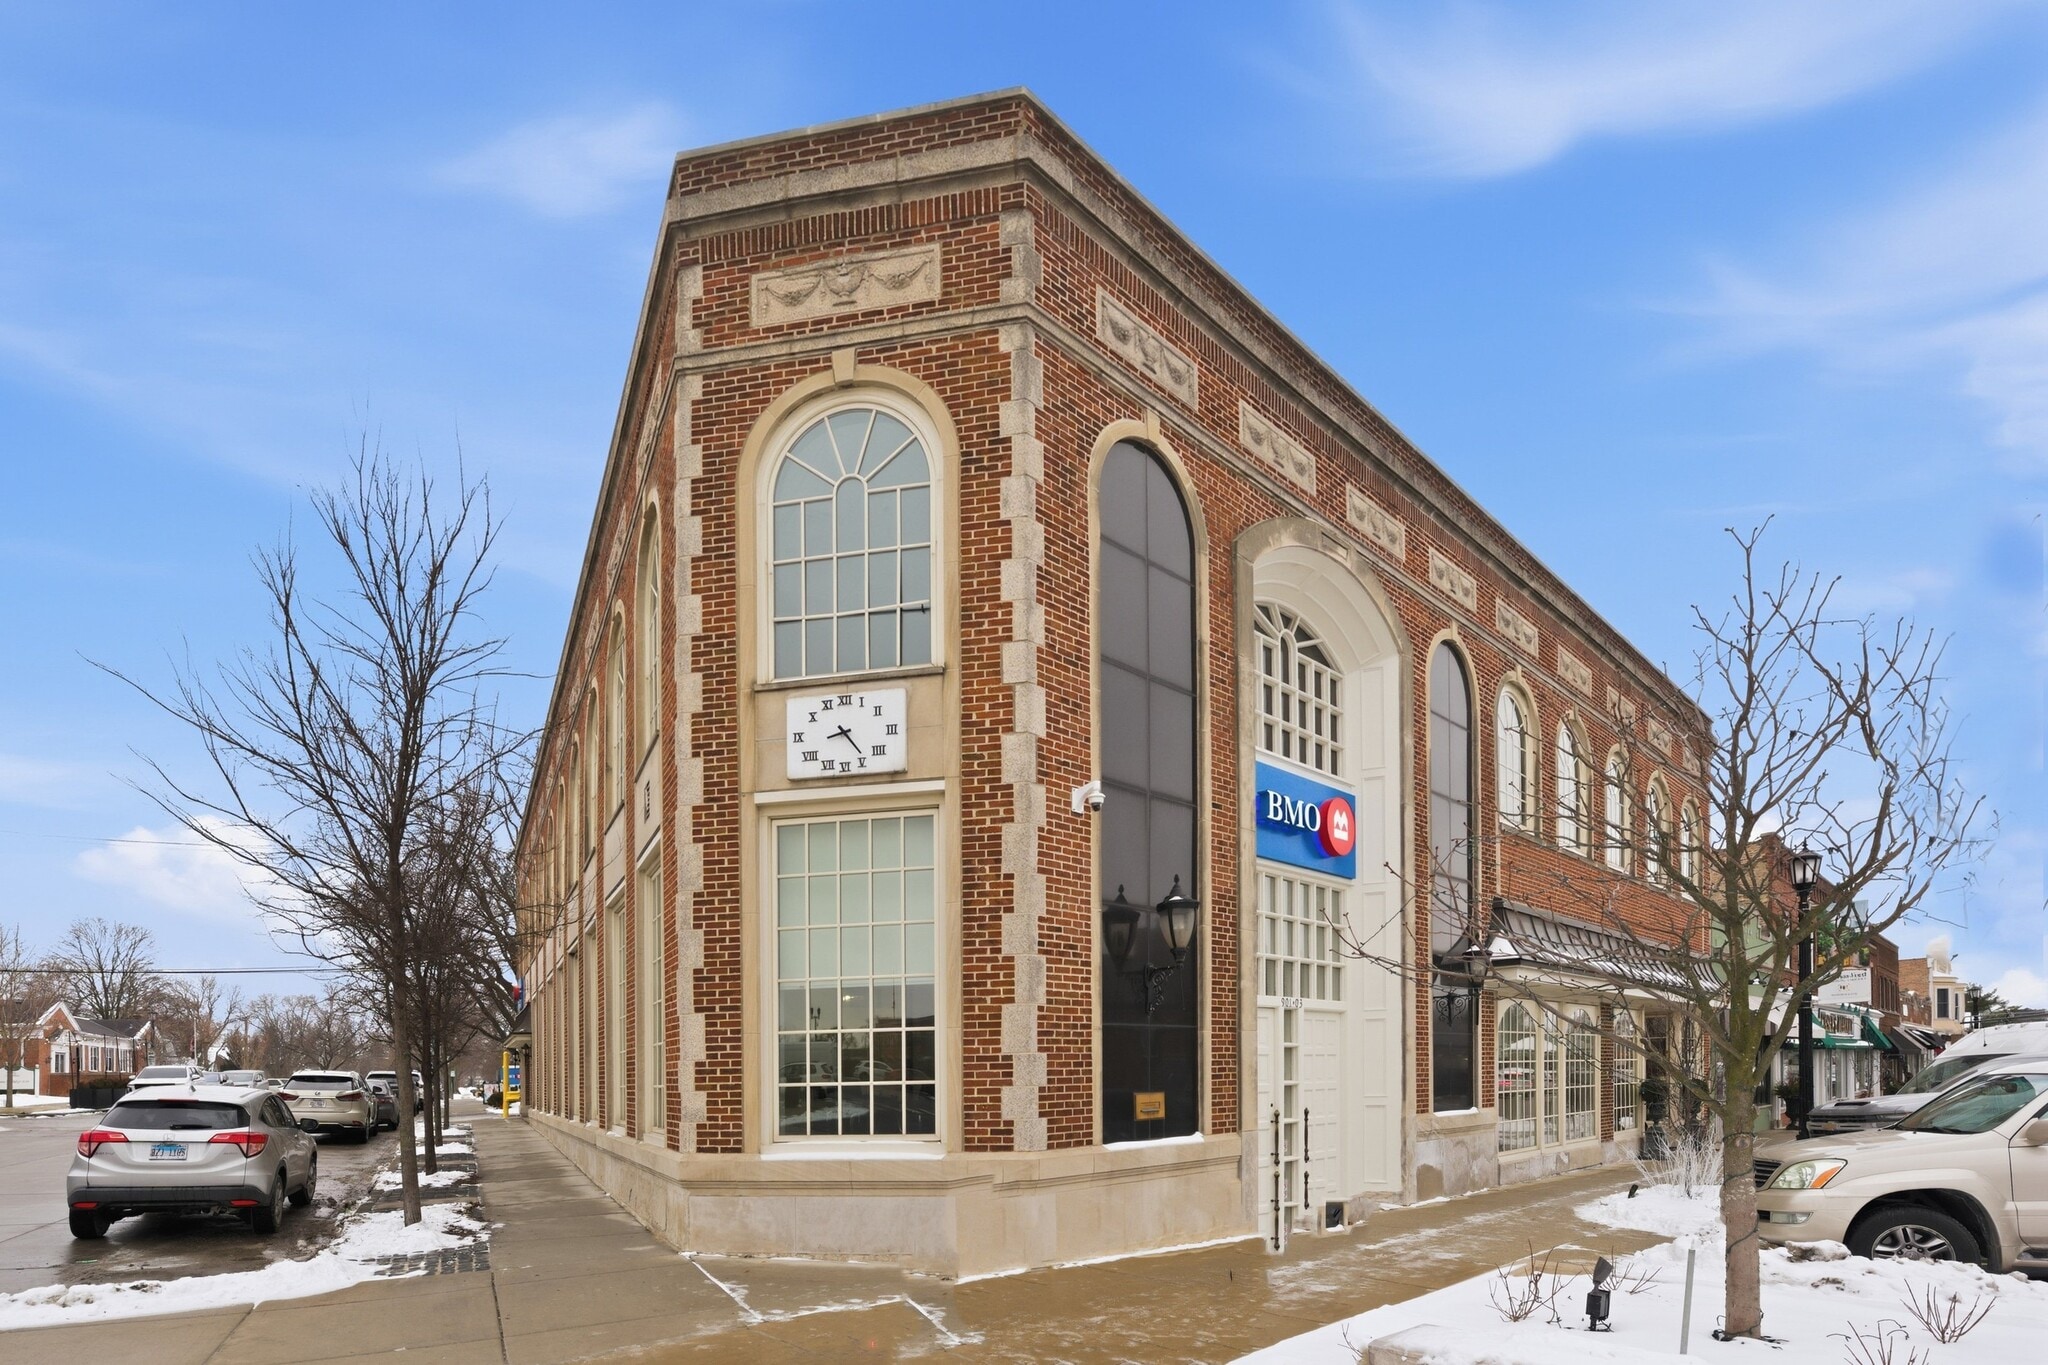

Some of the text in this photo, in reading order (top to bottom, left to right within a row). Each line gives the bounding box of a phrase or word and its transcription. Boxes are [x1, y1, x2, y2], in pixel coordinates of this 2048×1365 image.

[821, 699, 834, 710] XI
[837, 694, 853, 706] XII
[859, 696, 865, 707] I
[873, 705, 882, 716] II
[808, 711, 818, 722] X
[885, 723, 898, 735] III
[793, 732, 805, 742] IX
[871, 744, 886, 755] IIII
[801, 750, 819, 761] VIII
[821, 759, 835, 770] VII
[839, 761, 851, 772] VI
[857, 757, 867, 767] V
[1266, 789, 1321, 832] BMO
